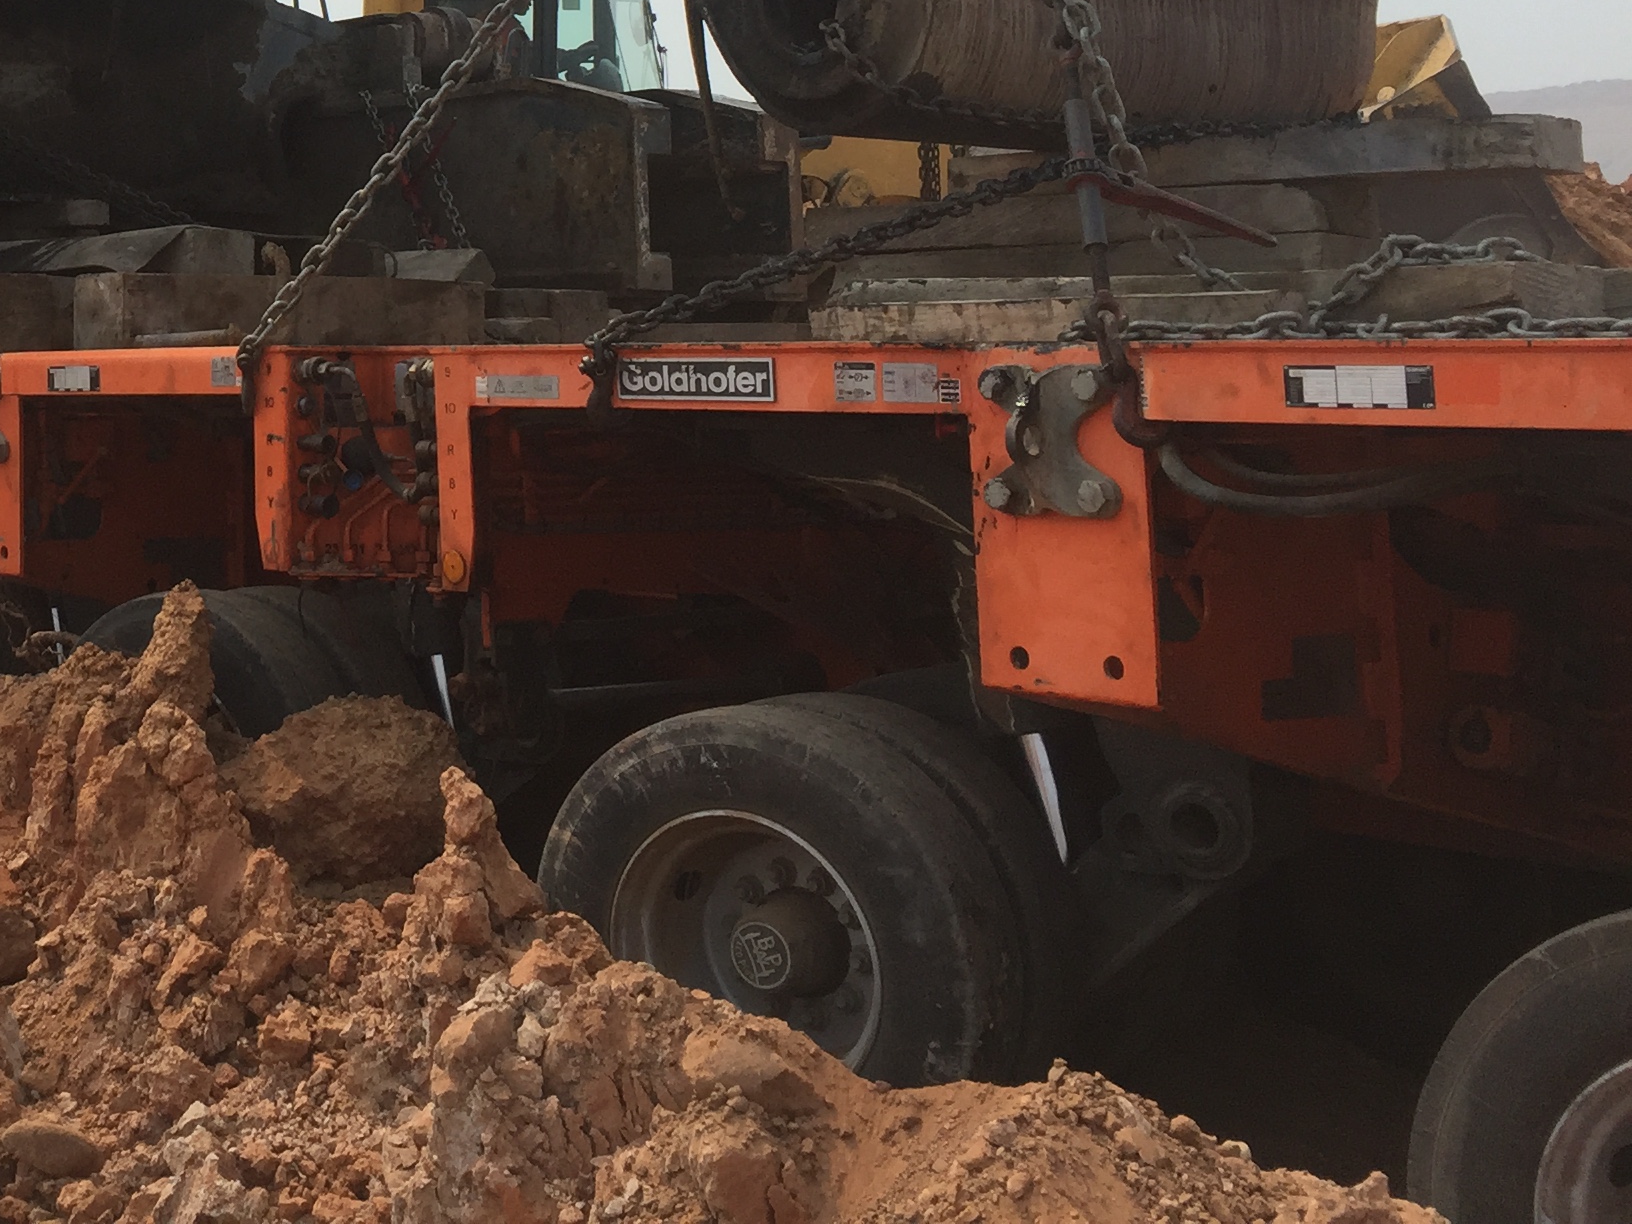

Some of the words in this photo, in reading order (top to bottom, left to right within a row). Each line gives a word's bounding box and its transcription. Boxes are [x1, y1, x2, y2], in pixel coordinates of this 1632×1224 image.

[621, 364, 767, 393] Goldhofer
[444, 403, 456, 414] 10
[447, 444, 454, 456] R
[451, 509, 458, 520] Y
